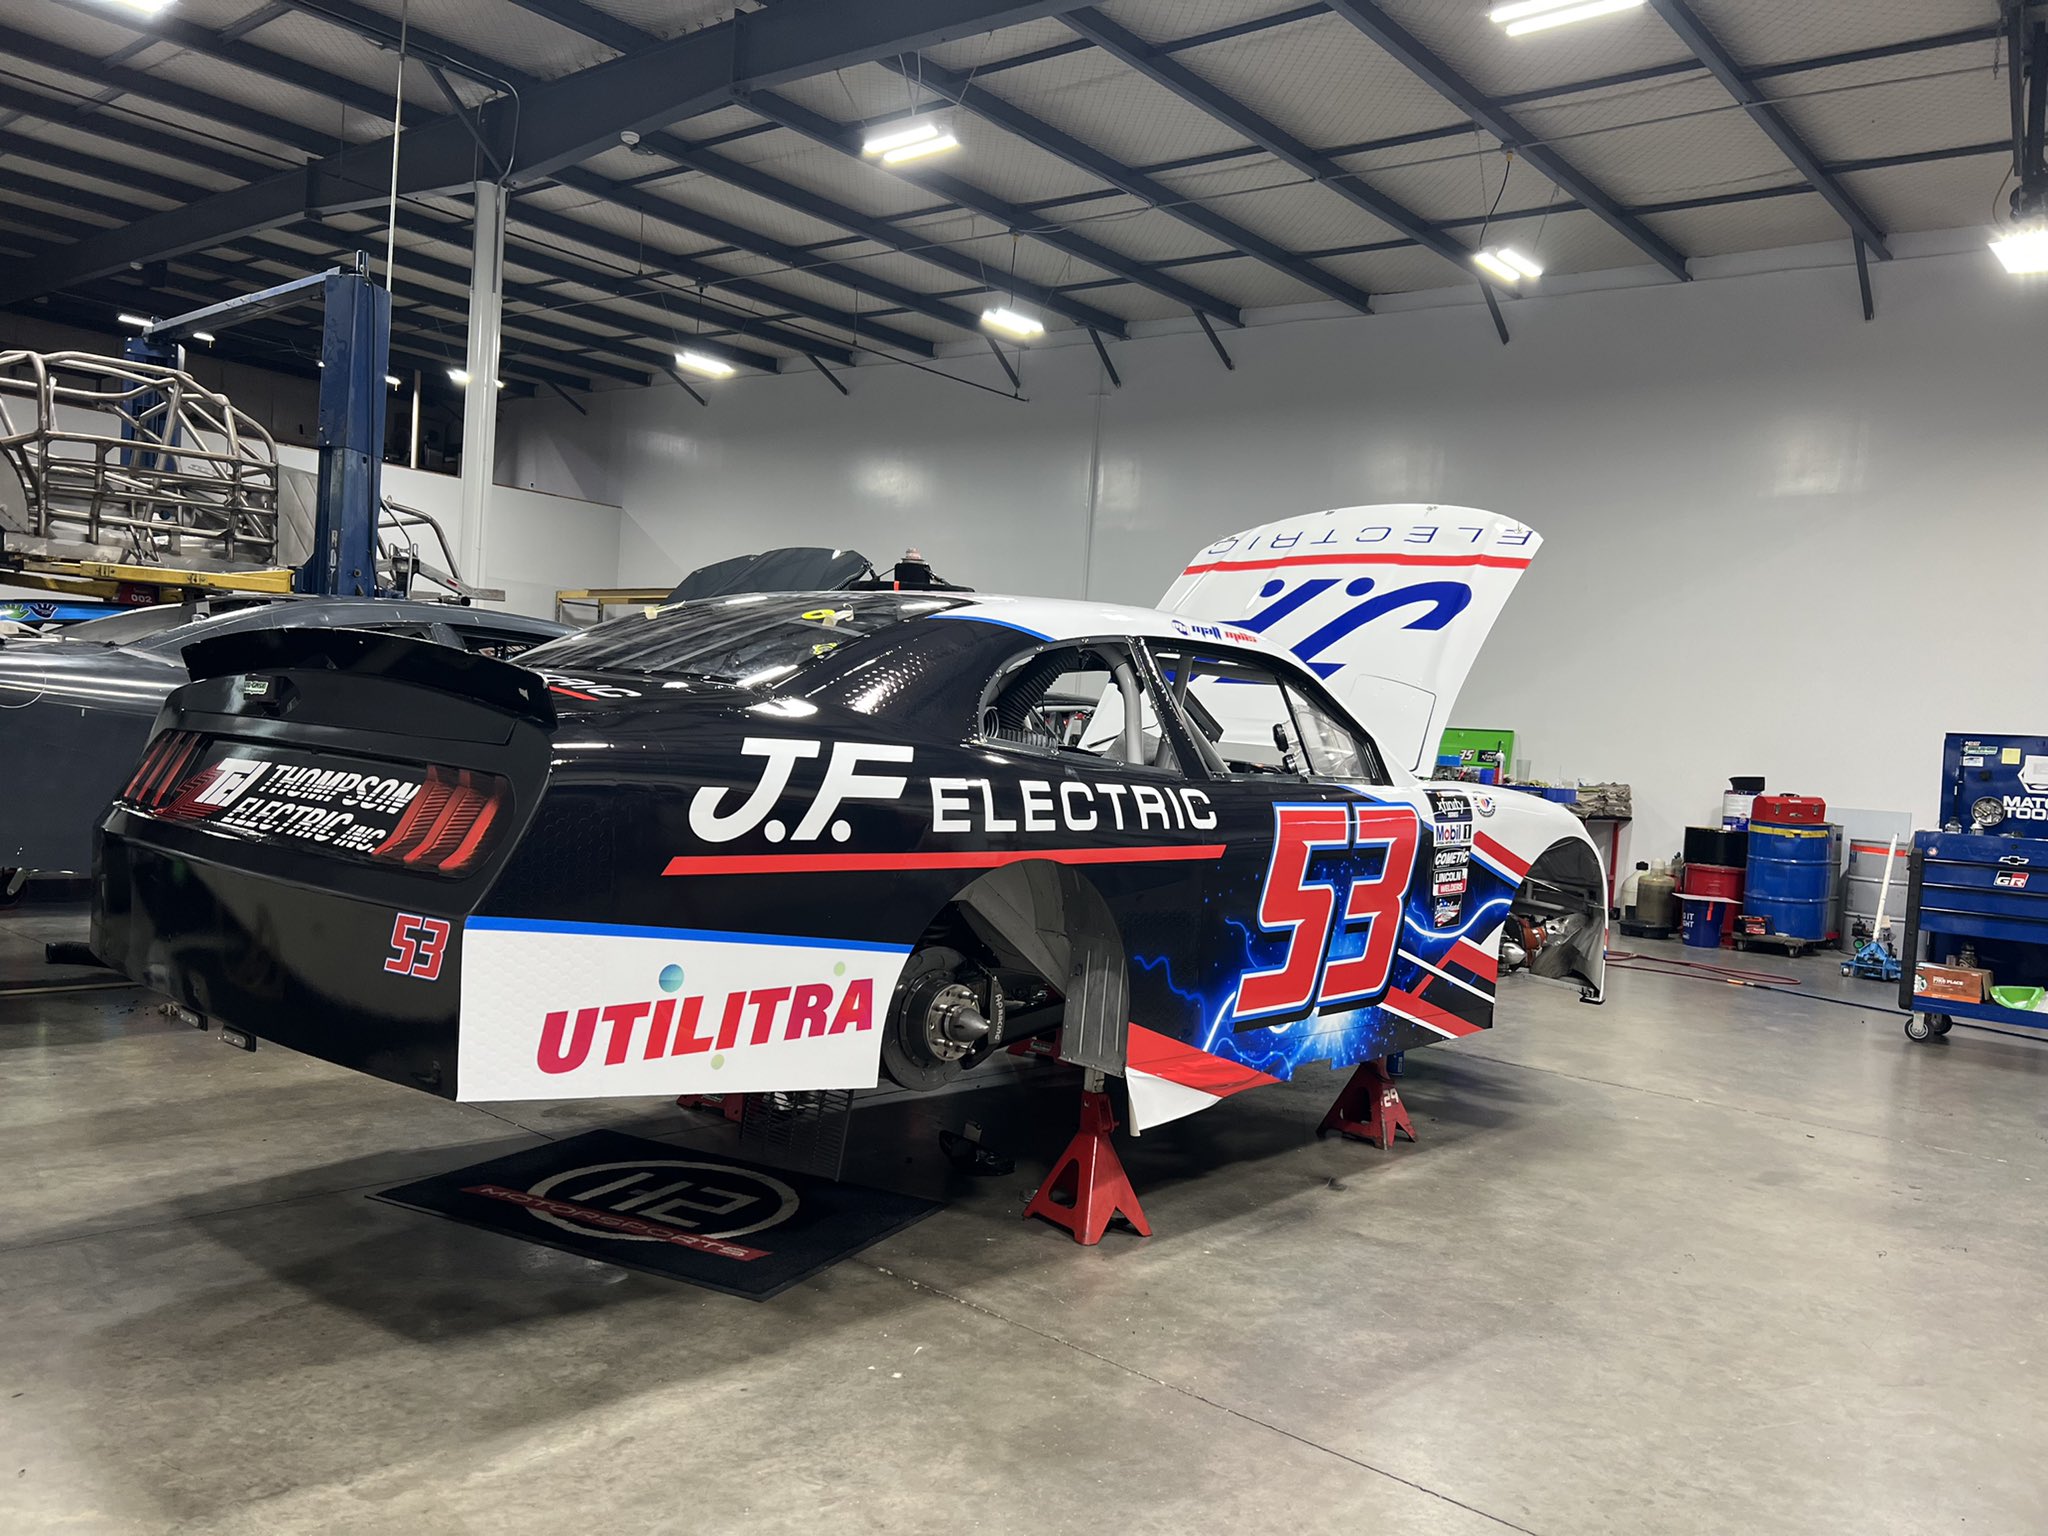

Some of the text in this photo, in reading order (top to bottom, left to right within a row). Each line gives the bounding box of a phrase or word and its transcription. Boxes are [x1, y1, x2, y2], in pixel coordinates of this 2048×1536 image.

[1208, 526, 1533, 555] ELECTRIC
[131, 593, 153, 604] 002
[258, 764, 422, 815] THOMPSON
[689, 737, 1217, 843] J.F. ELECTRIC
[1436, 798, 1464, 815] xfinity
[2004, 806, 2048, 820] TOO
[220, 797, 354, 842] ELECTRIC
[1436, 824, 1471, 841] Mobil 1
[1434, 850, 1470, 865] COMETIC
[1435, 871, 1462, 883] LINCOLN
[1440, 882, 1463, 893] WELDERS
[1232, 801, 1424, 1025] 53
[384, 912, 450, 980] 53
[536, 963, 874, 1075] UTILITRA
[1382, 1087, 1399, 1107] 29
[479, 1186, 752, 1258] MOTORSPORTS
